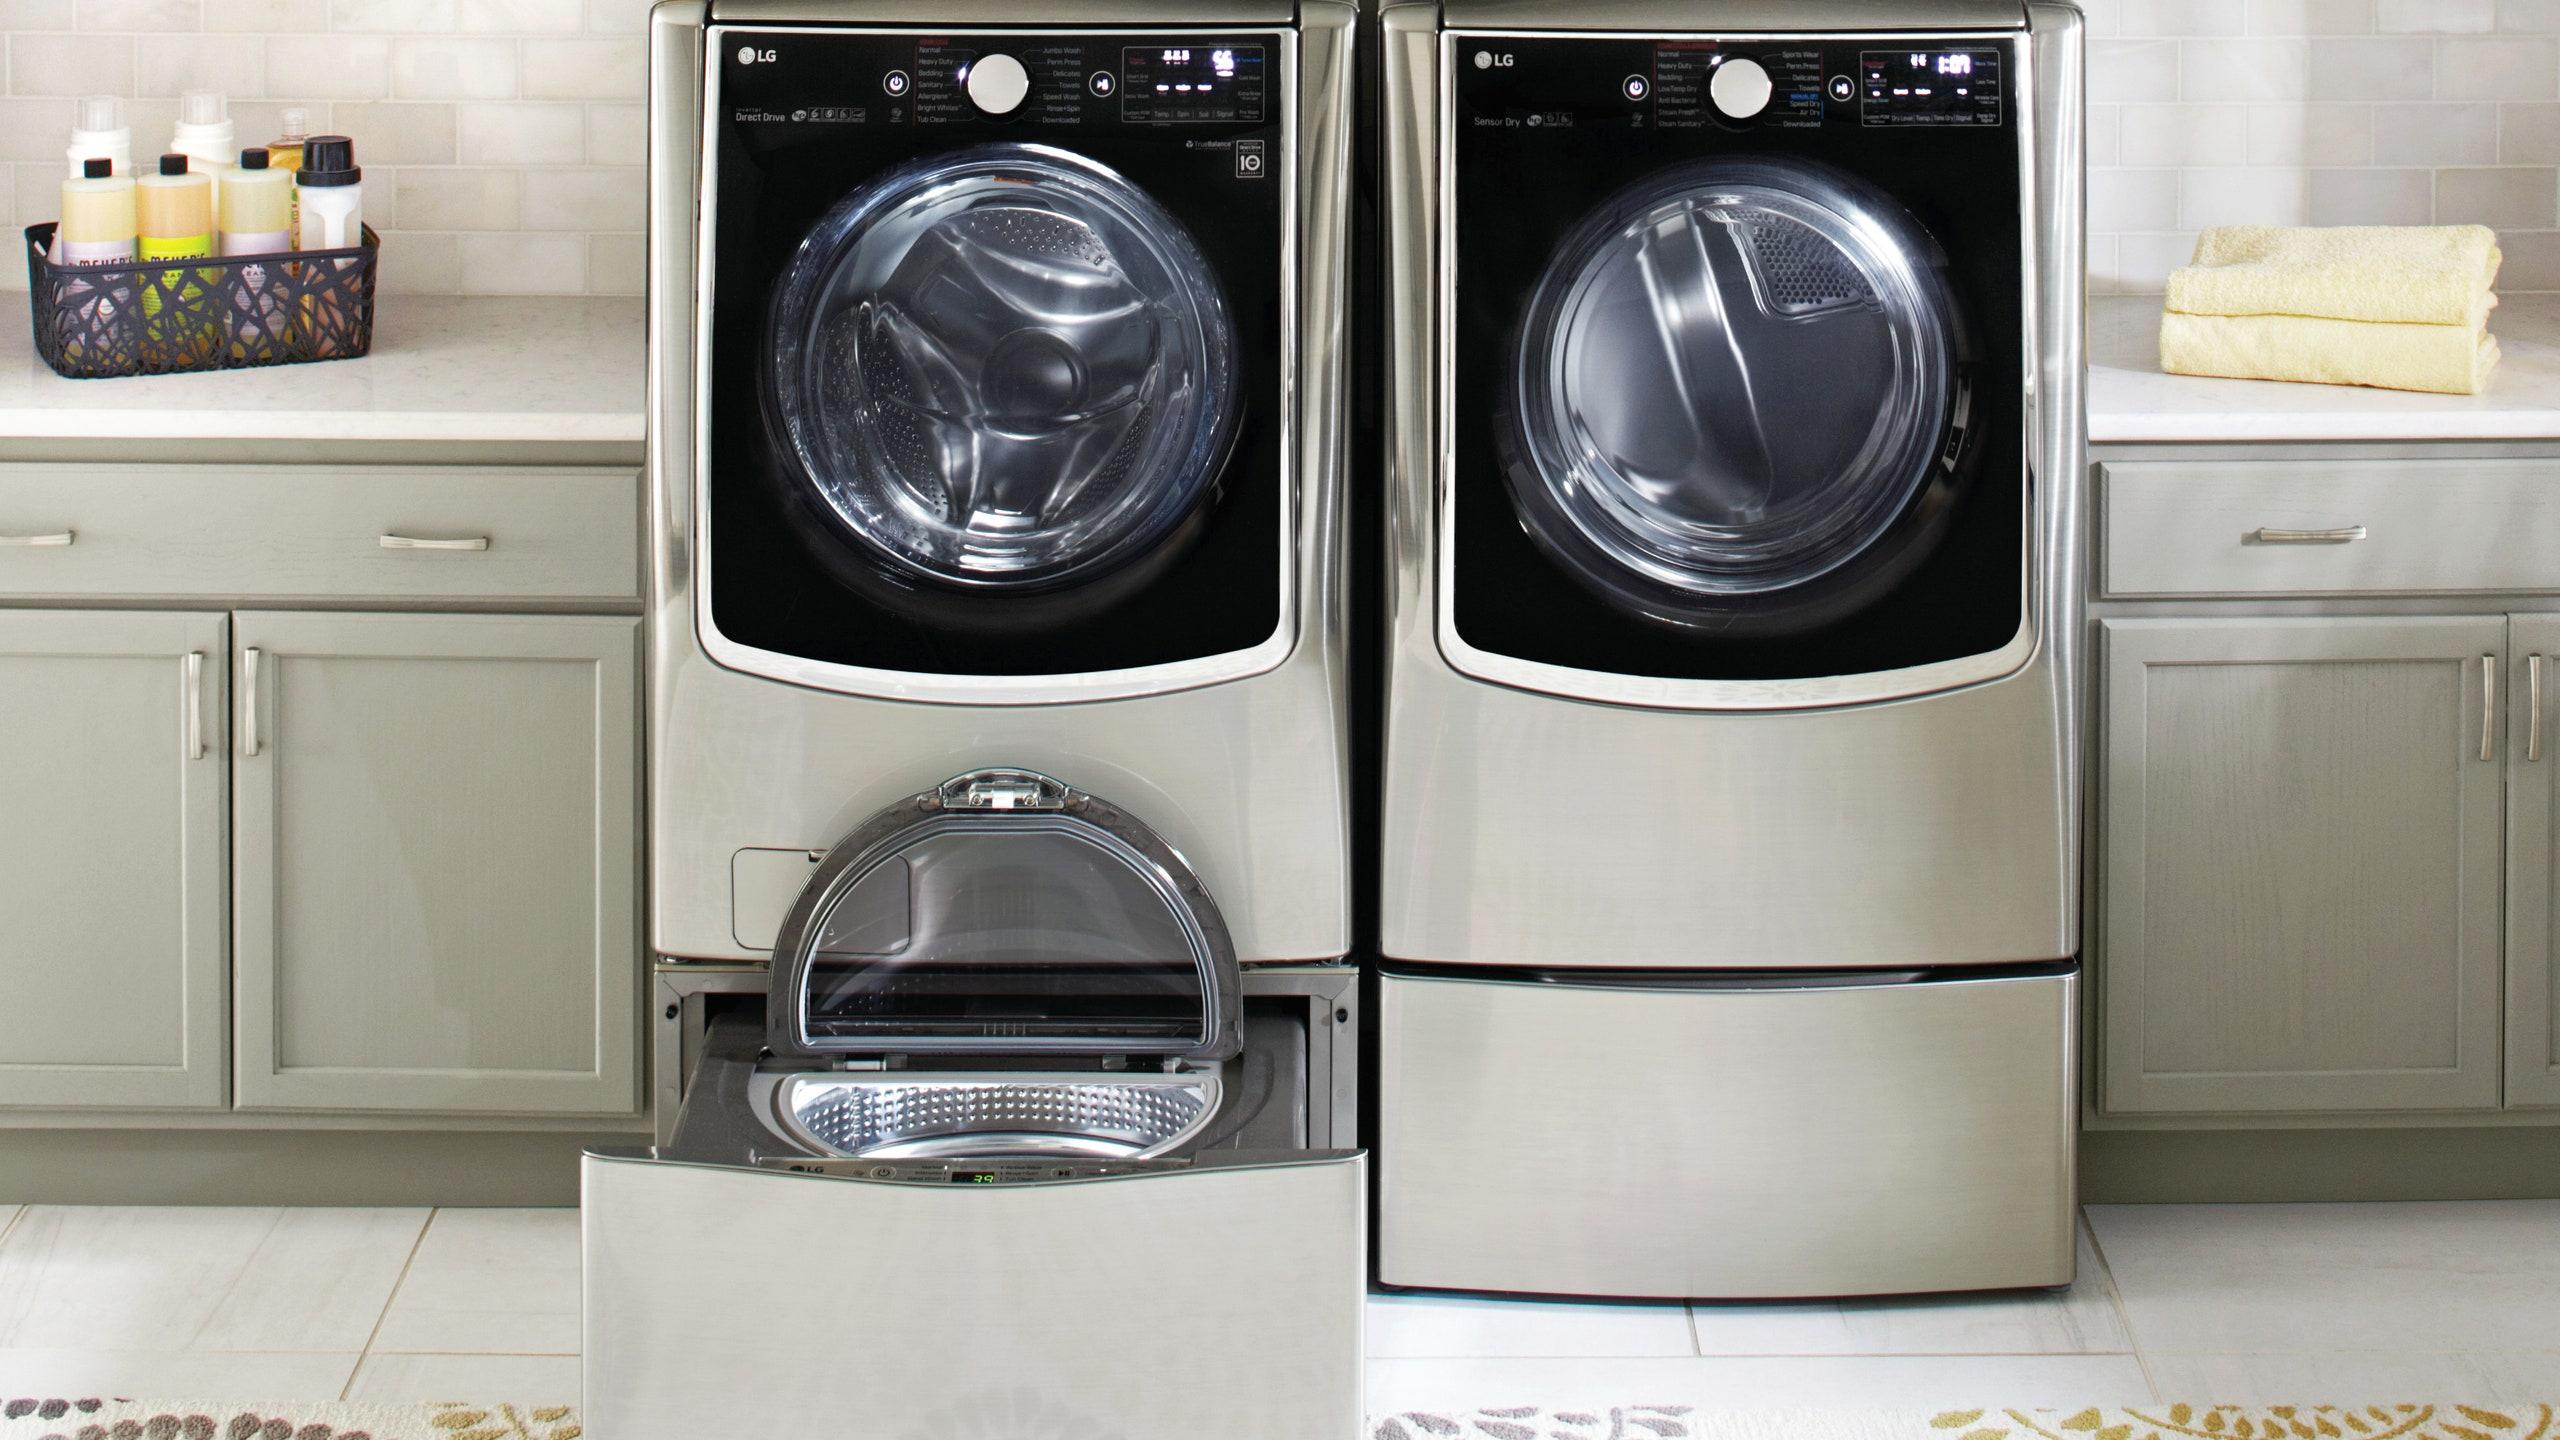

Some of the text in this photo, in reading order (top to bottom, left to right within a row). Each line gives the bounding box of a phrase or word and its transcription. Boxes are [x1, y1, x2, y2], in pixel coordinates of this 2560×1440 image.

[757, 50, 776, 62] LG
[1494, 54, 1514, 66] LG
[1658, 74, 1682, 82] Bedding
[736, 113, 761, 122] Direct
[763, 113, 786, 122] Drive
[1475, 117, 1502, 126] Sensor
[1505, 117, 1520, 128] Dry
[1240, 155, 1260, 171] 10
[973, 1174, 994, 1184] 39
